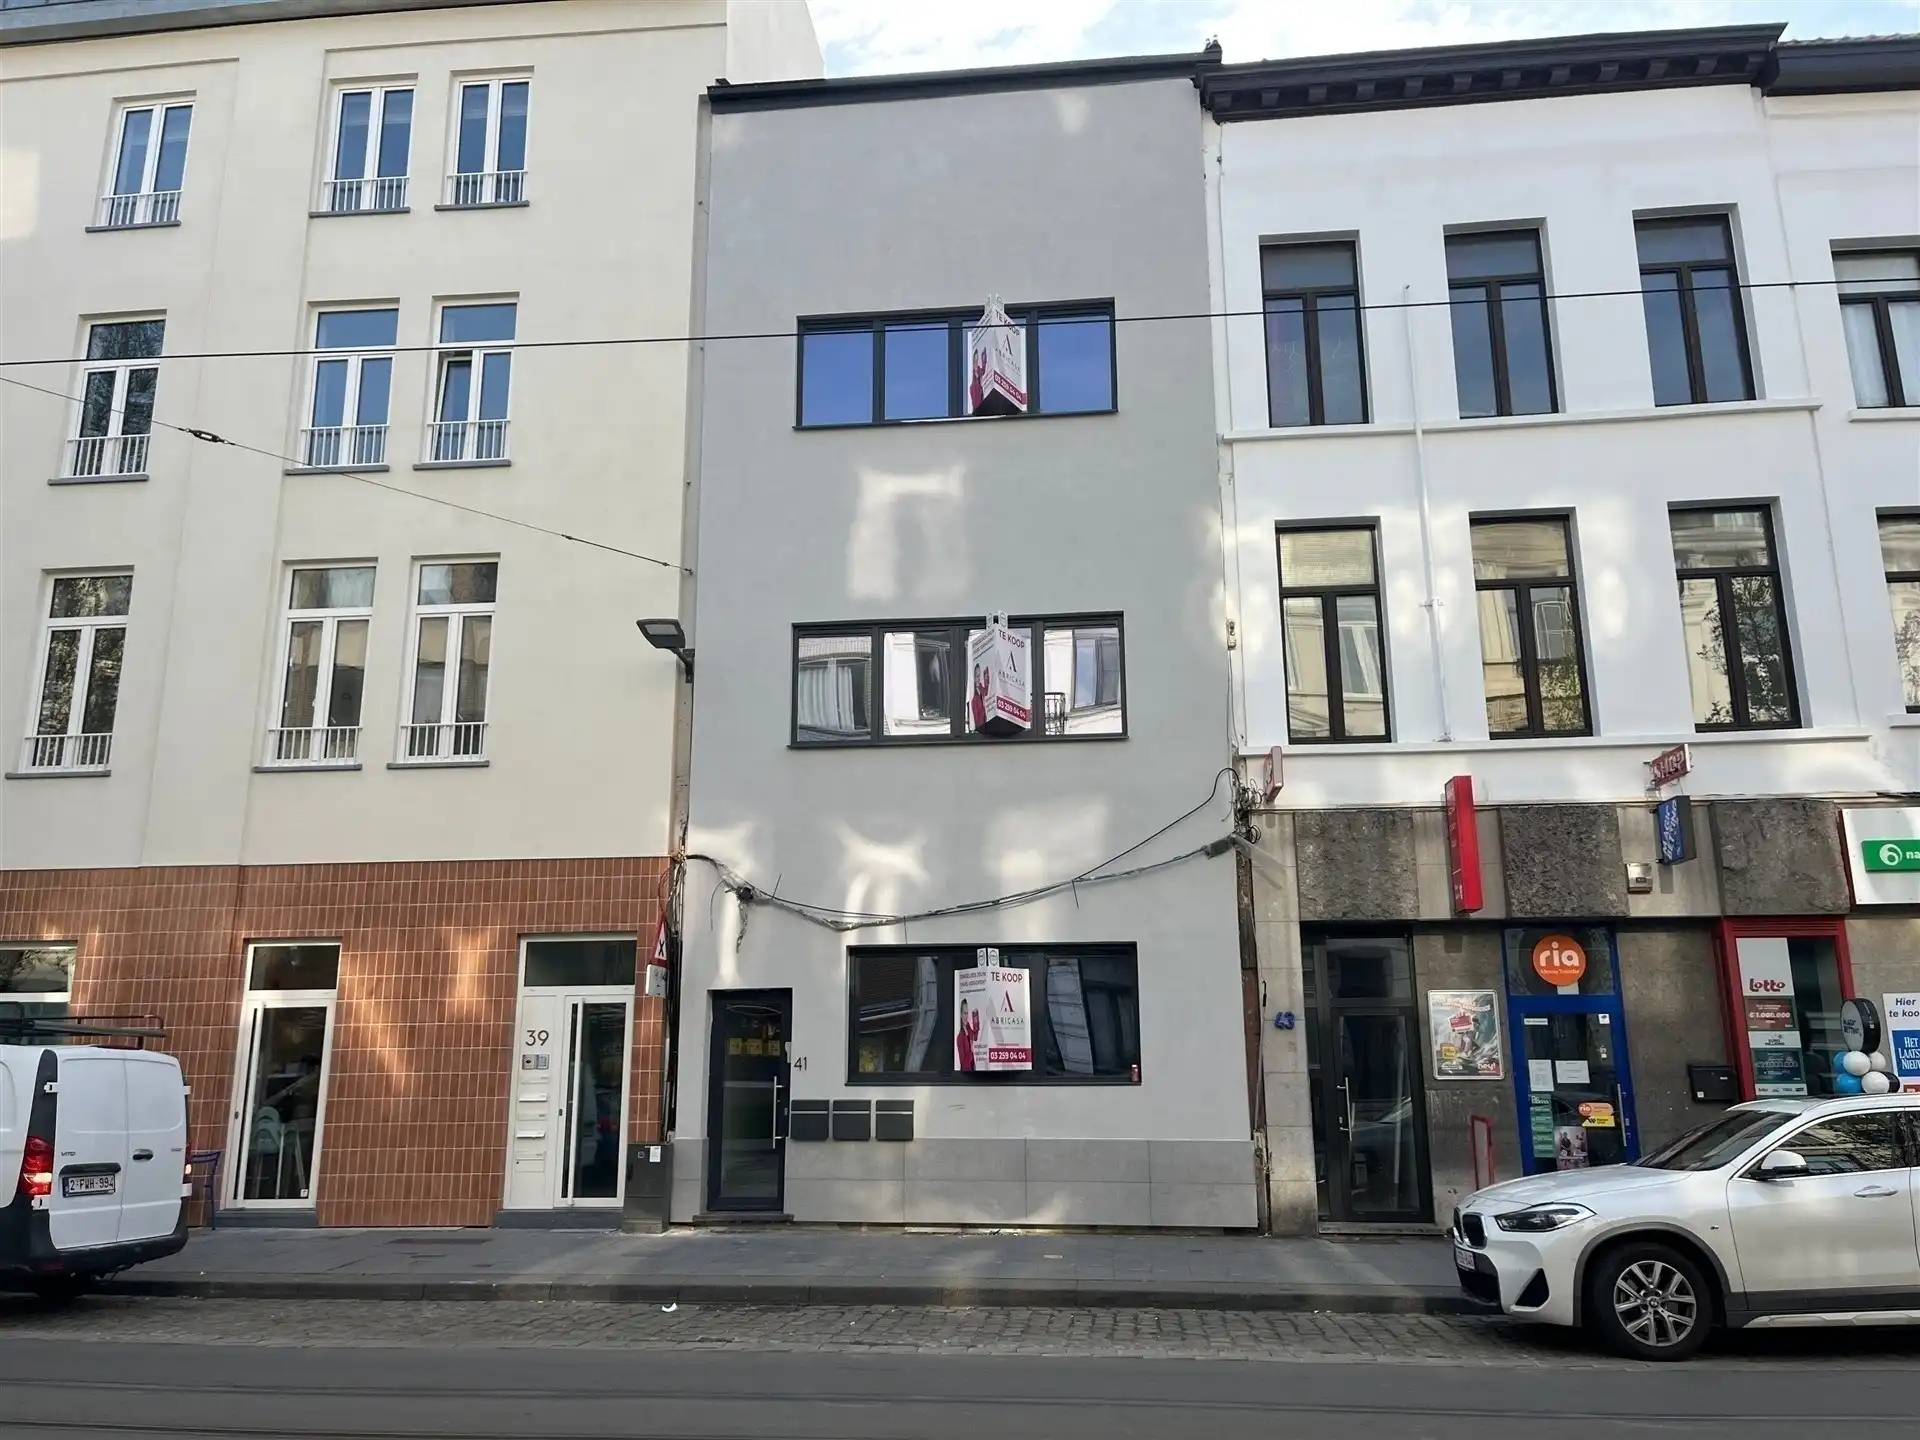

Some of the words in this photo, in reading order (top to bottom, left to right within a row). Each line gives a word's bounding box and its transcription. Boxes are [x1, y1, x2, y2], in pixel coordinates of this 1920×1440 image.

[999, 629, 1006, 641] TE
[1007, 634, 1025, 649] KOOP
[998, 669, 1025, 687] ABRICASA
[997, 699, 1004, 708] 03
[1013, 707, 1020, 715] 04
[1019, 710, 1026, 718] 04
[1653, 750, 1685, 779] SHOP
[1539, 941, 1580, 967] ria
[990, 971, 1000, 982] TE
[1002, 972, 1023, 983] KOOP
[1895, 997, 1917, 1006] Hier
[990, 1017, 1025, 1025] ABRICASA
[1889, 1009, 1899, 1018] te
[525, 1029, 549, 1047] 39
[1904, 1036, 1918, 1048] HET
[990, 1052, 998, 1060] 03
[999, 1052, 1009, 1060] 259
[1010, 1051, 1018, 1060] 04
[1018, 1051, 1026, 1060] 04
[793, 1056, 808, 1071] 41
